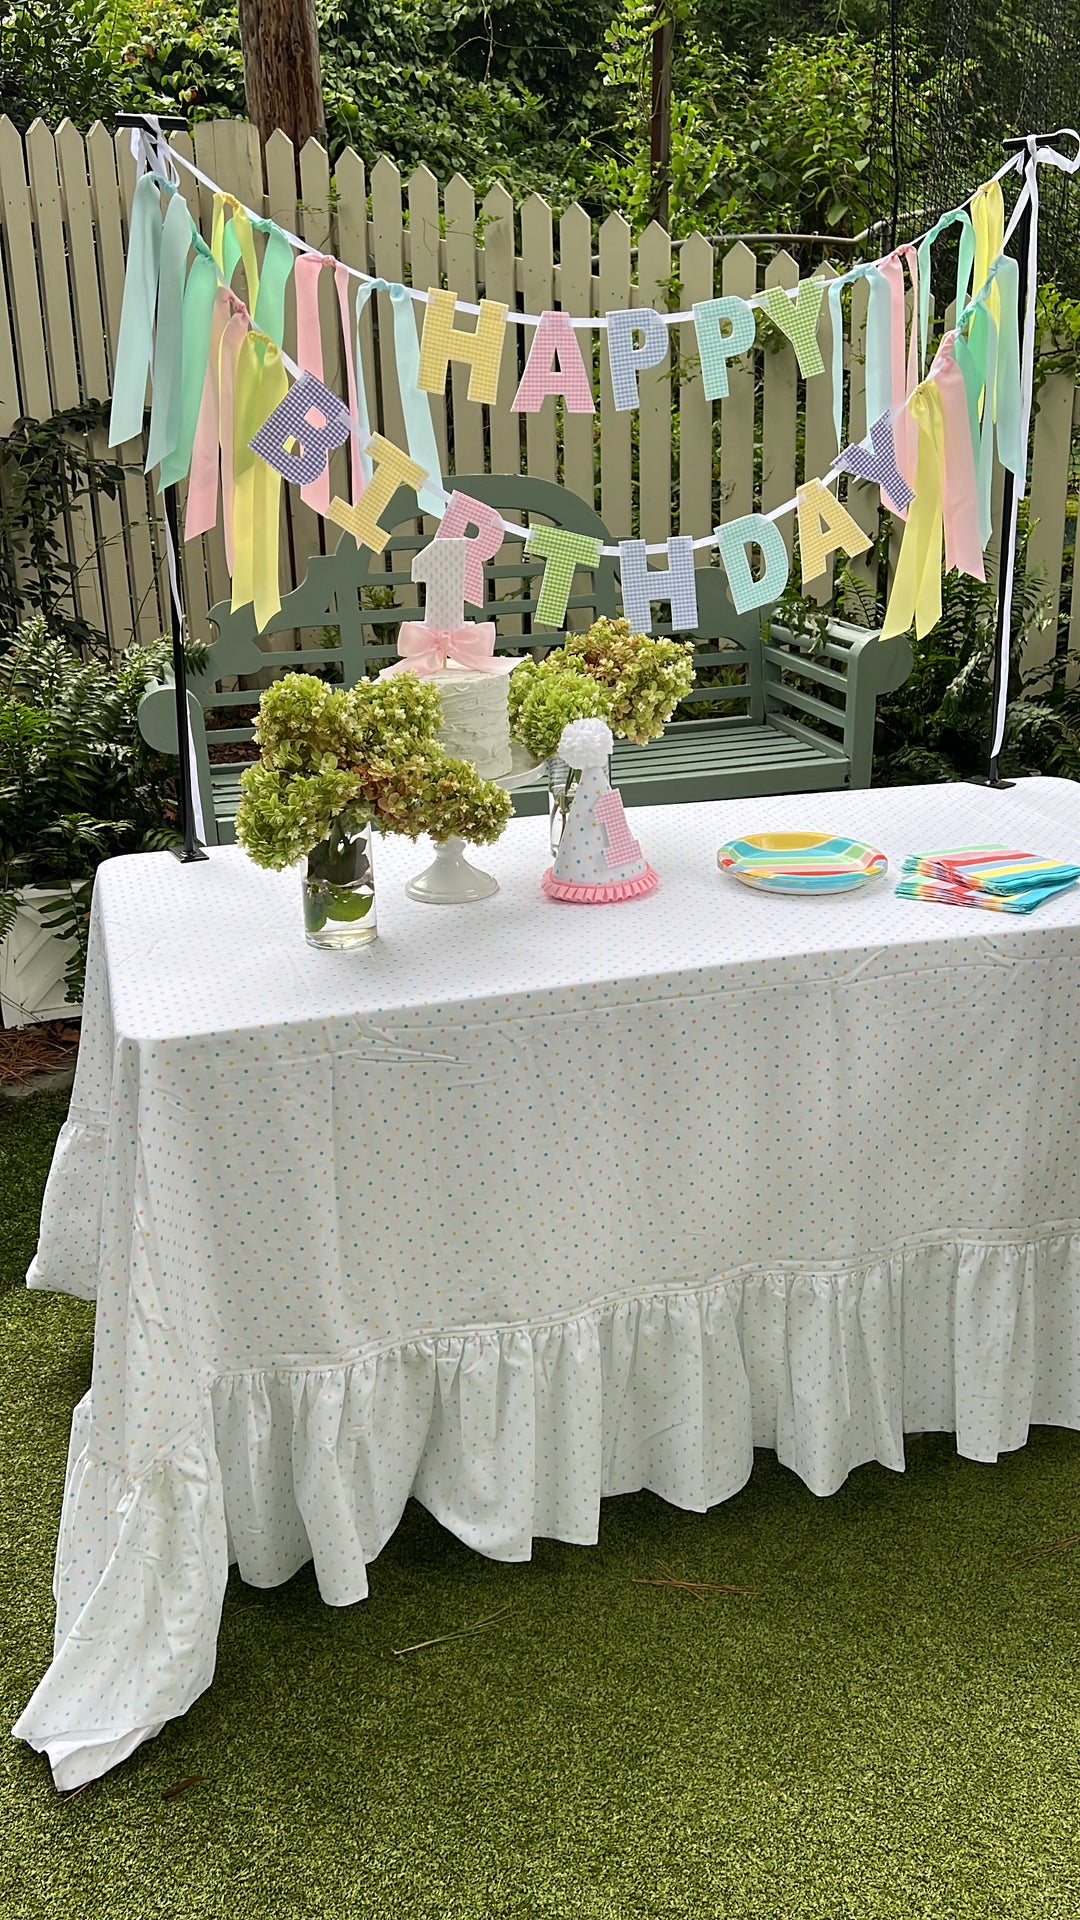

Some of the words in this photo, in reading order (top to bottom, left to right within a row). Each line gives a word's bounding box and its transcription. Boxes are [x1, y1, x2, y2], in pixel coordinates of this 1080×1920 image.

[417, 275, 825, 414] HAPPY
[248, 369, 916, 633] BIRTHDAY
[411, 537, 467, 630] 1
[594, 788, 643, 868] 1
